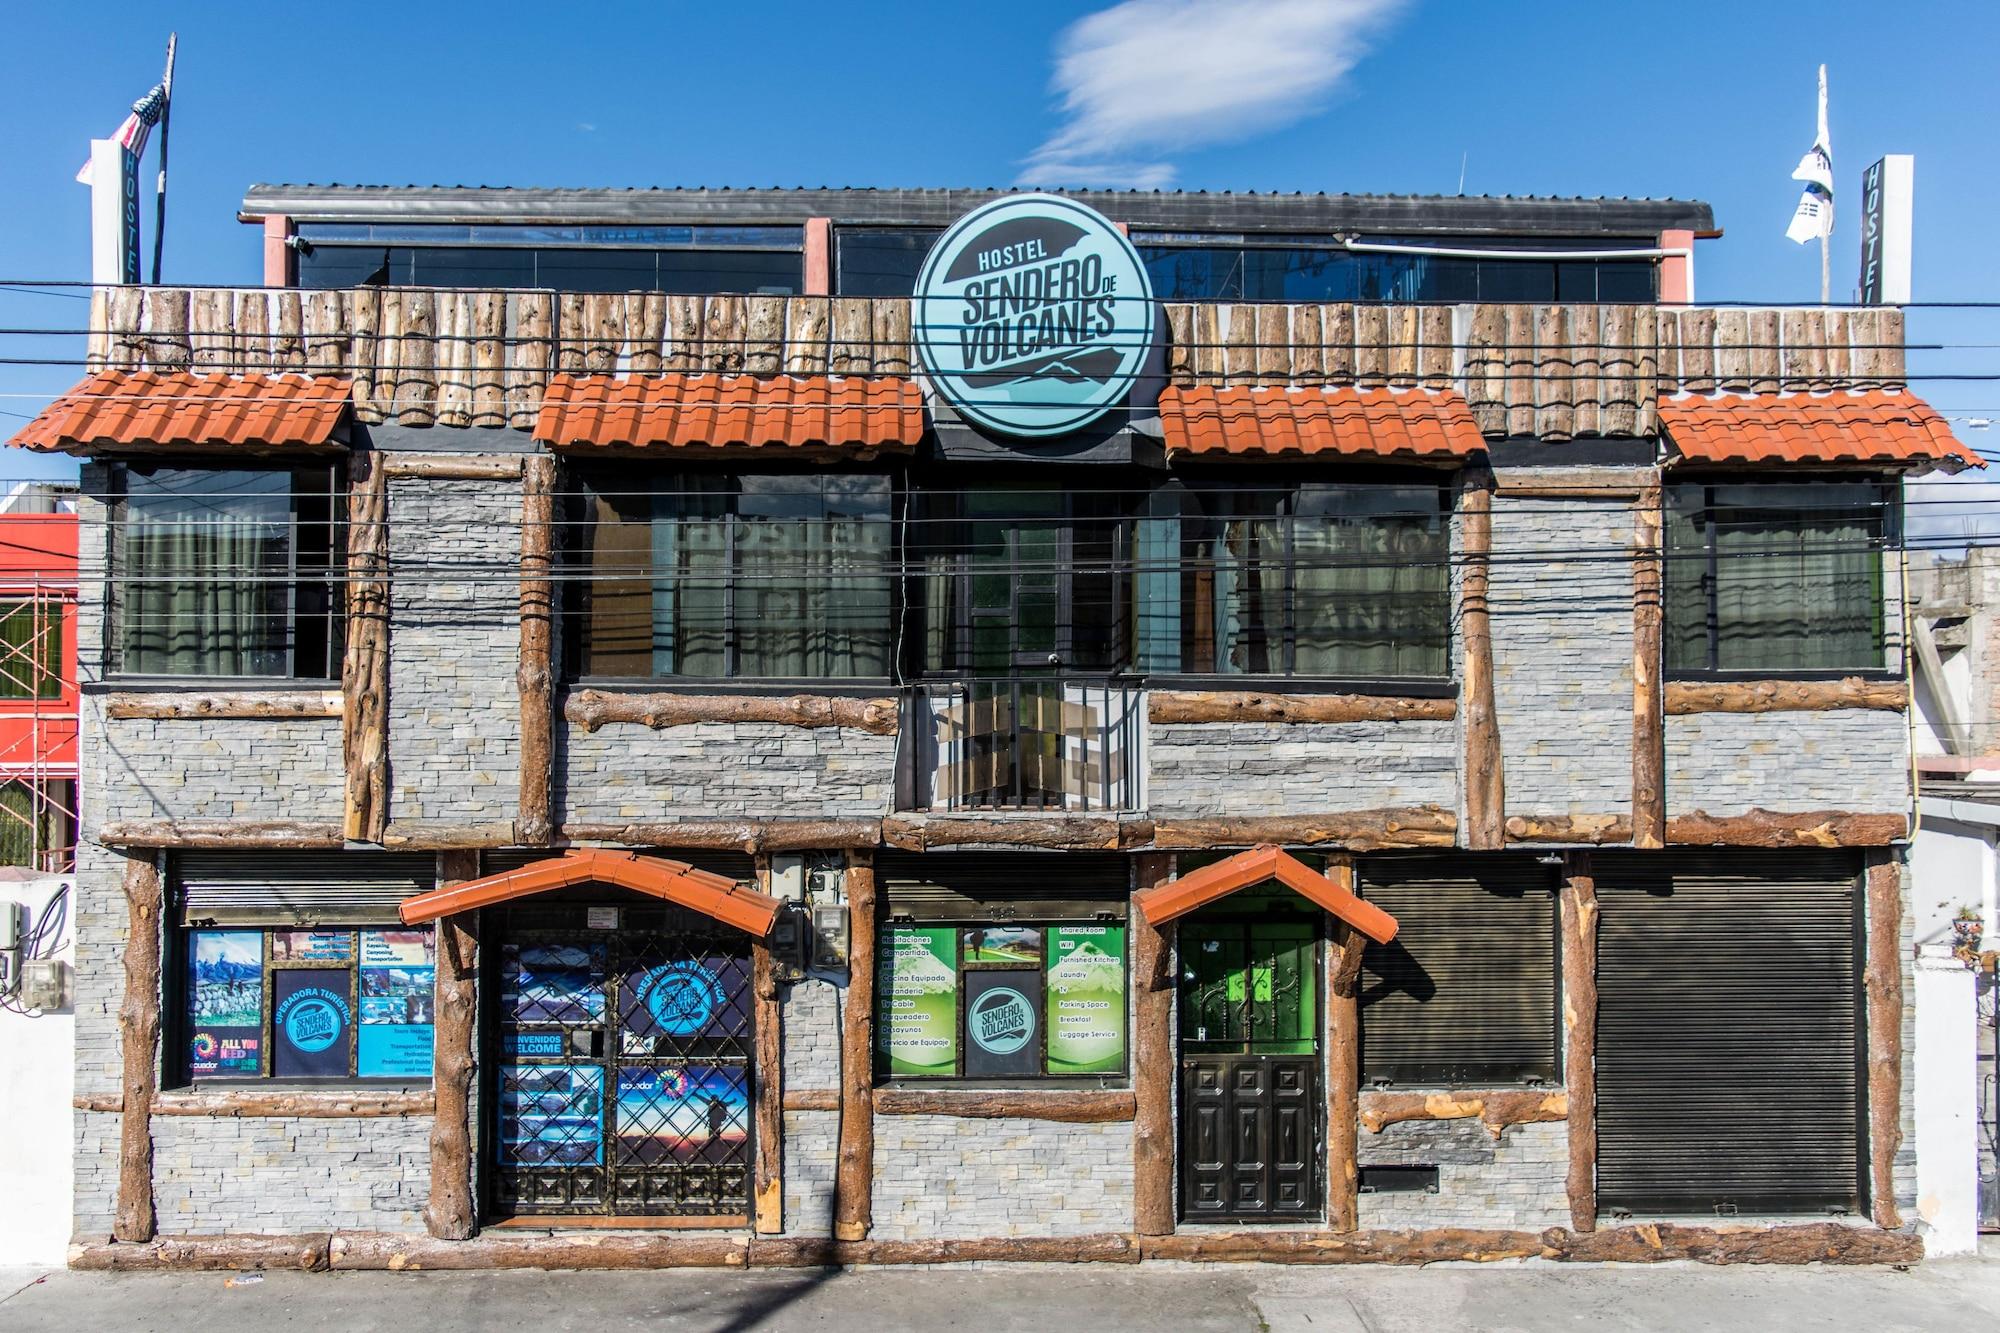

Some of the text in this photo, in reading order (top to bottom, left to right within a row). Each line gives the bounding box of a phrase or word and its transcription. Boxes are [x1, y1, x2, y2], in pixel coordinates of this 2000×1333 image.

[978, 238, 1047, 271] HOSTEL
[963, 254, 1117, 325] SENDERO DE
[960, 294, 1115, 370] VOLCANES
[882, 949, 929, 957] Compartidas
[1060, 971, 1087, 979] Laundry
[276, 988, 318, 1024] OPERADORA
[1060, 1001, 1086, 1009] Parking
[982, 1002, 1020, 1025] SENDERO
[981, 1014, 1024, 1038] VOLCANES
[1060, 1031, 1090, 1039] Luggage
[220, 1039, 258, 1050] ALL YOU
[921, 1039, 949, 1047] Equipaje
[504, 1044, 561, 1053] WELCOME
[220, 1049, 247, 1059] NEED
